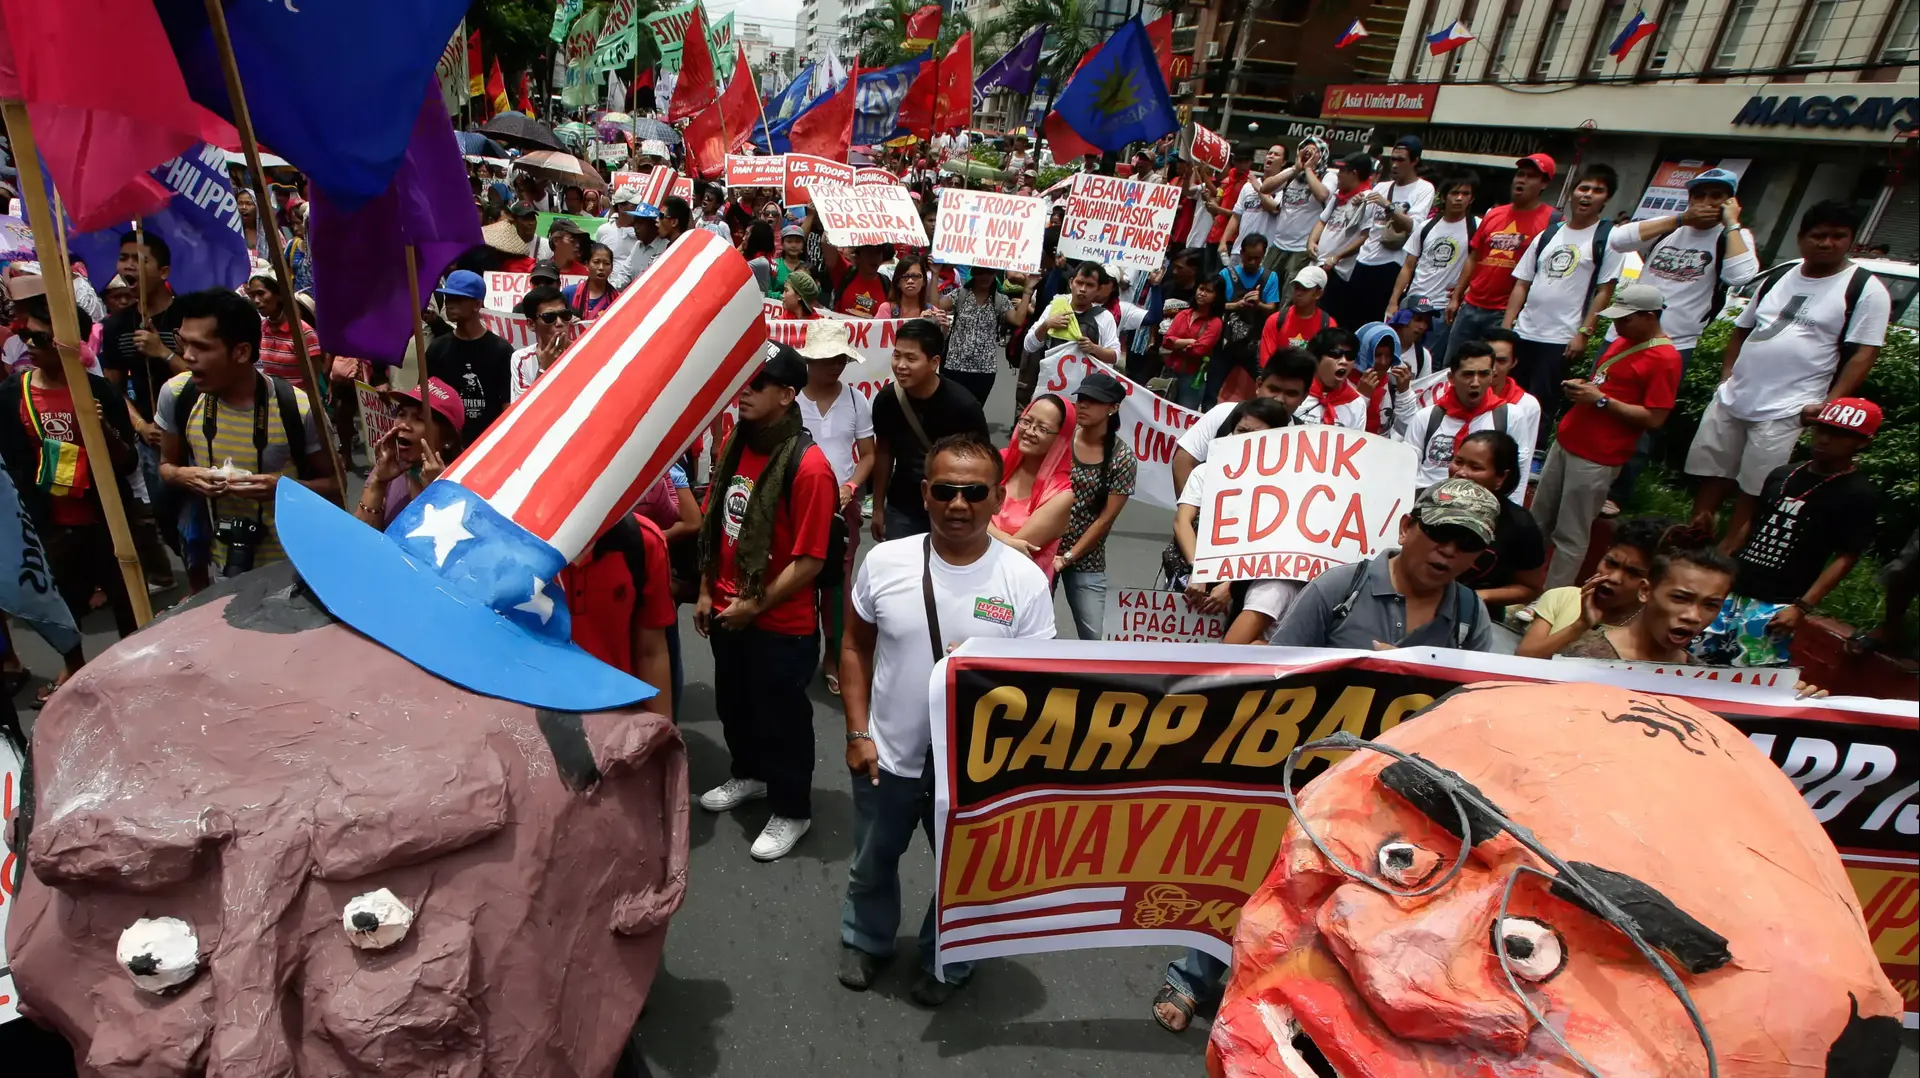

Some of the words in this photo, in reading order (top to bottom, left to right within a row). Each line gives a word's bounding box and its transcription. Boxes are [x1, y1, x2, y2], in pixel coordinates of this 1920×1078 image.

[1342, 94, 1363, 108] Asia
[1364, 94, 1395, 109] United
[1395, 93, 1424, 109] Bank
[793, 175, 815, 188] OUT
[814, 163, 850, 180] TROOPS
[853, 186, 905, 201] BARREL
[1071, 174, 1145, 204] LABANAN
[1146, 185, 1179, 210] ANG
[824, 199, 887, 214] SYSTEM
[970, 195, 1036, 219] TROOPS
[1065, 196, 1158, 228] PANGHIHIMASOK
[1157, 222, 1169, 231] NG
[825, 212, 915, 231] IBASURA!
[942, 213, 980, 235] OUT
[985, 217, 1024, 241] NOW
[936, 233, 977, 254] JUNK
[985, 238, 1029, 260] VFA!
[1099, 222, 1171, 252] PILIPINAS!
[1817, 403, 1867, 427] LORD
[1223, 430, 1367, 480] JUNK
[1217, 553, 1330, 581] ANAKPA
[977, 602, 1012, 616] HYPER
[986, 610, 1013, 621] TONE
[966, 685, 1209, 784] CARP
[954, 803, 1157, 896] TUNAY
[1159, 803, 1261, 882] NA
